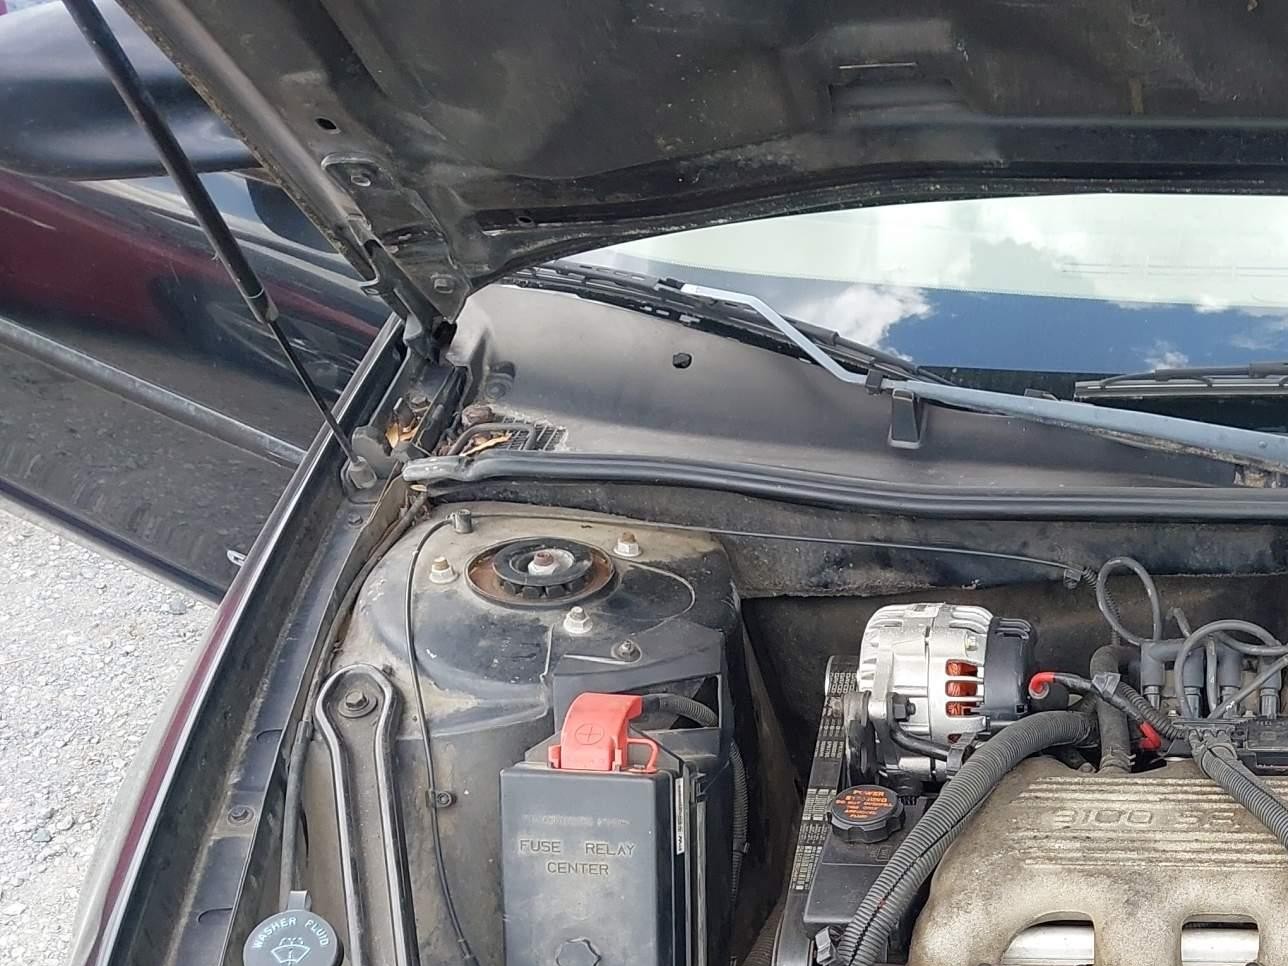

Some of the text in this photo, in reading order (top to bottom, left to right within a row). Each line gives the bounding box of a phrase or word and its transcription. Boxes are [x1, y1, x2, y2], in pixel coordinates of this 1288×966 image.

[1053, 808, 1152, 829] 3100
[519, 838, 636, 856] FUSE RELAY
[546, 861, 610, 876] CENTER
[251, 916, 330, 949] WASHER FLUID
